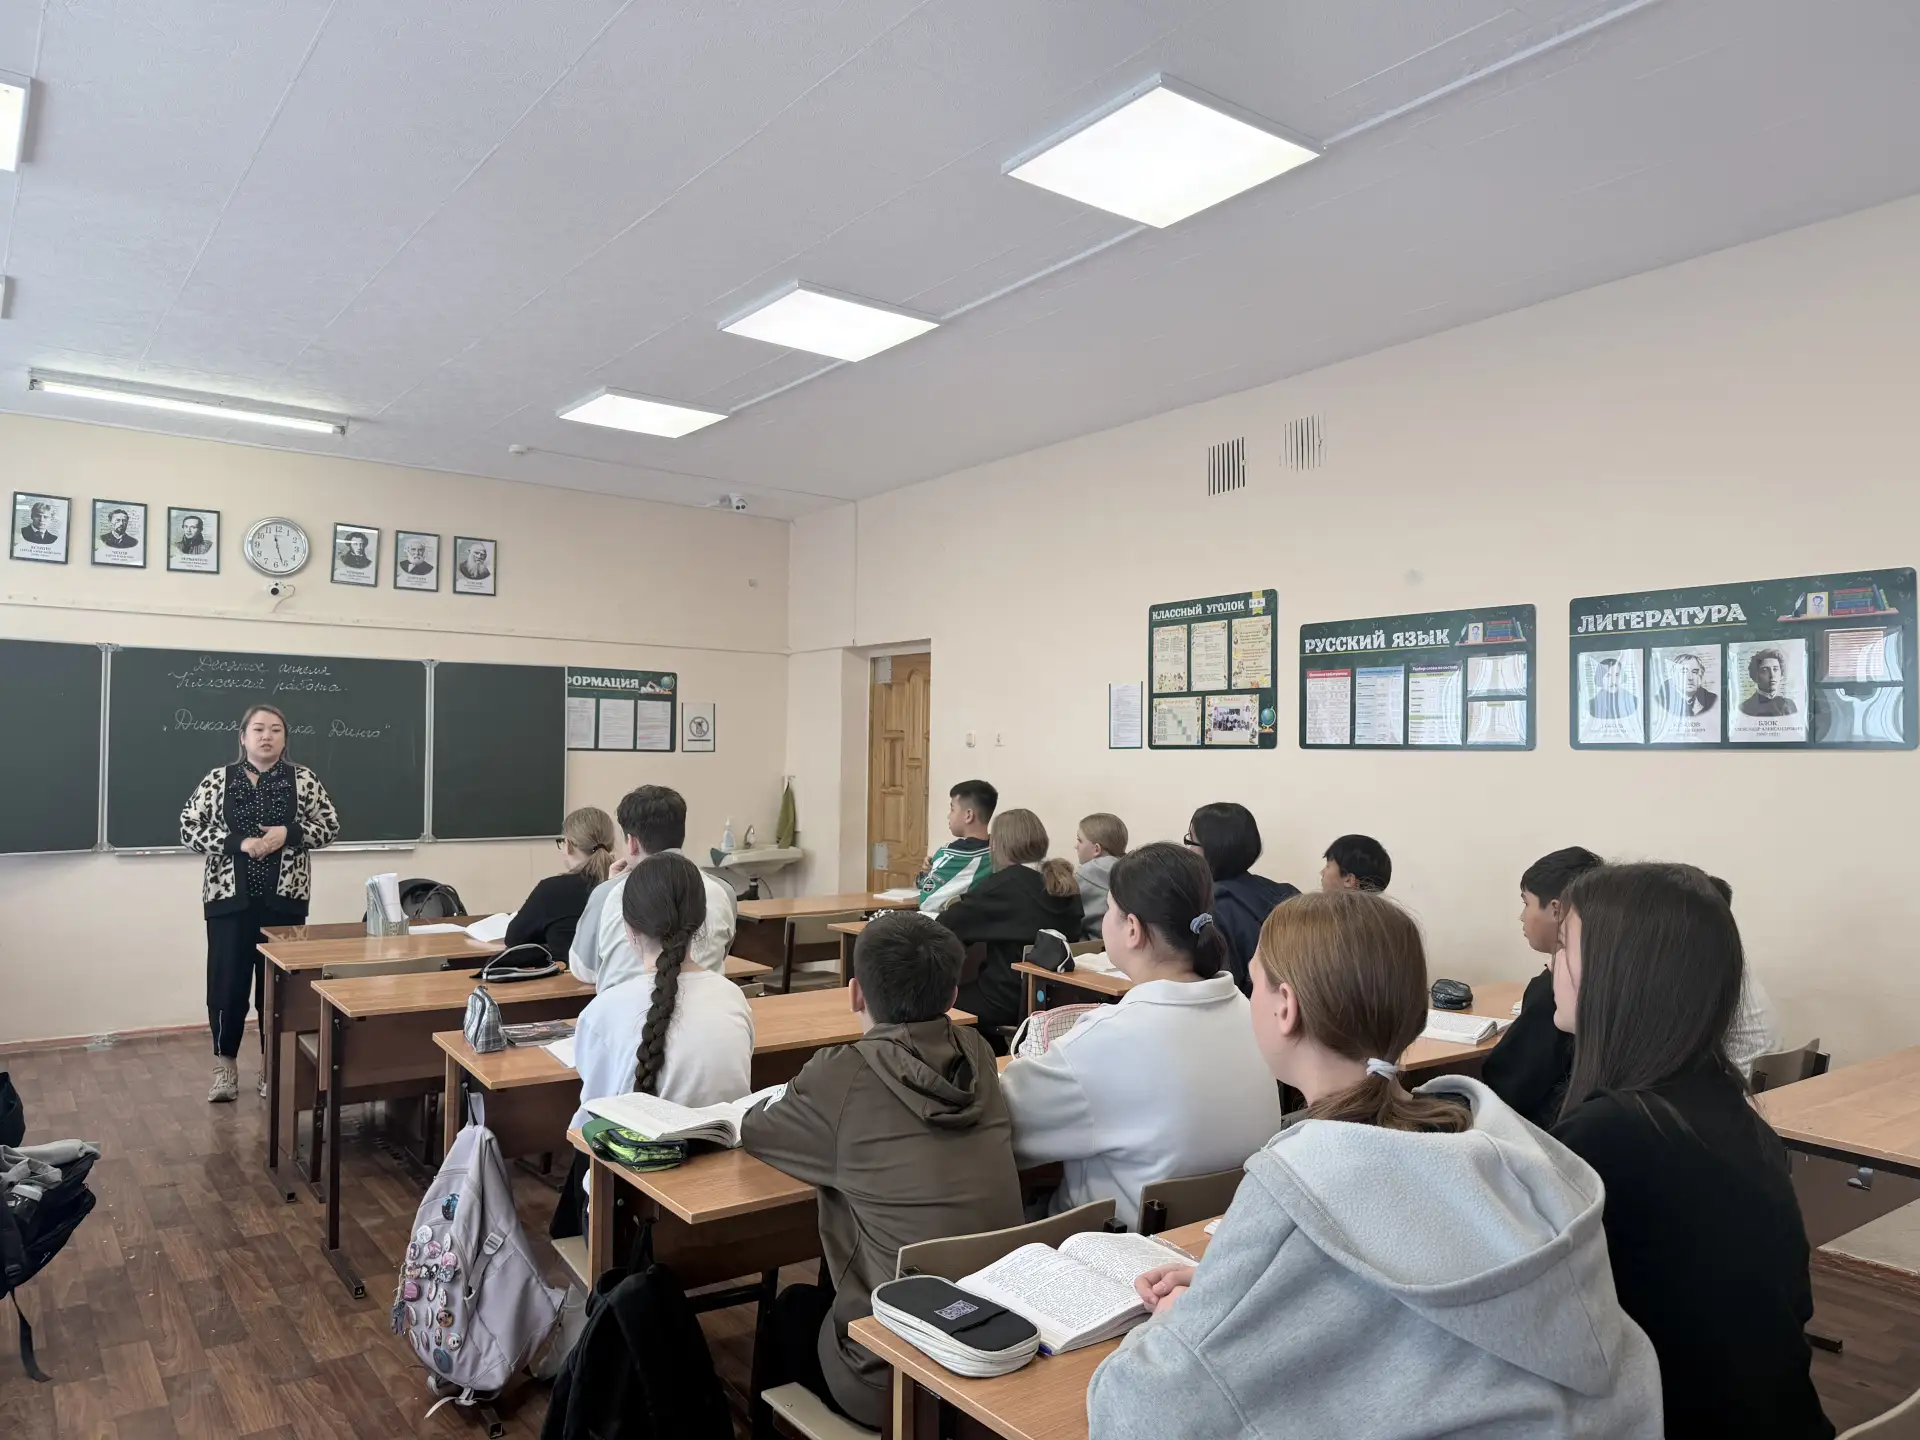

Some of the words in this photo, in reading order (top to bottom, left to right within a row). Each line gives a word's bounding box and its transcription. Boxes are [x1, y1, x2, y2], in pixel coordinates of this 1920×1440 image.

[265, 526, 272, 534] 11
[275, 525, 283, 533] 12
[286, 529, 290, 537] 1
[257, 532, 265, 540] 10
[292, 536, 298, 544] 2
[254, 540, 261, 548] 9
[294, 545, 300, 553] 3
[256, 550, 262, 558] 8
[290, 554, 296, 562] 4
[263, 557, 269, 565] 7
[273, 561, 279, 569] 6
[283, 559, 289, 567] 5
[1151, 603, 1203, 620] КЛАССНЫЙ
[1206, 599, 1245, 614] УГОЛОК
[1577, 603, 1747, 633] ЛИТЕРАТУРА
[1304, 629, 1386, 654] РУССКИЙ
[1391, 628, 1450, 649] ЯЗЫК
[567, 675, 640, 688] ОРМАЦИЯ
[287, 722, 317, 735] ака
